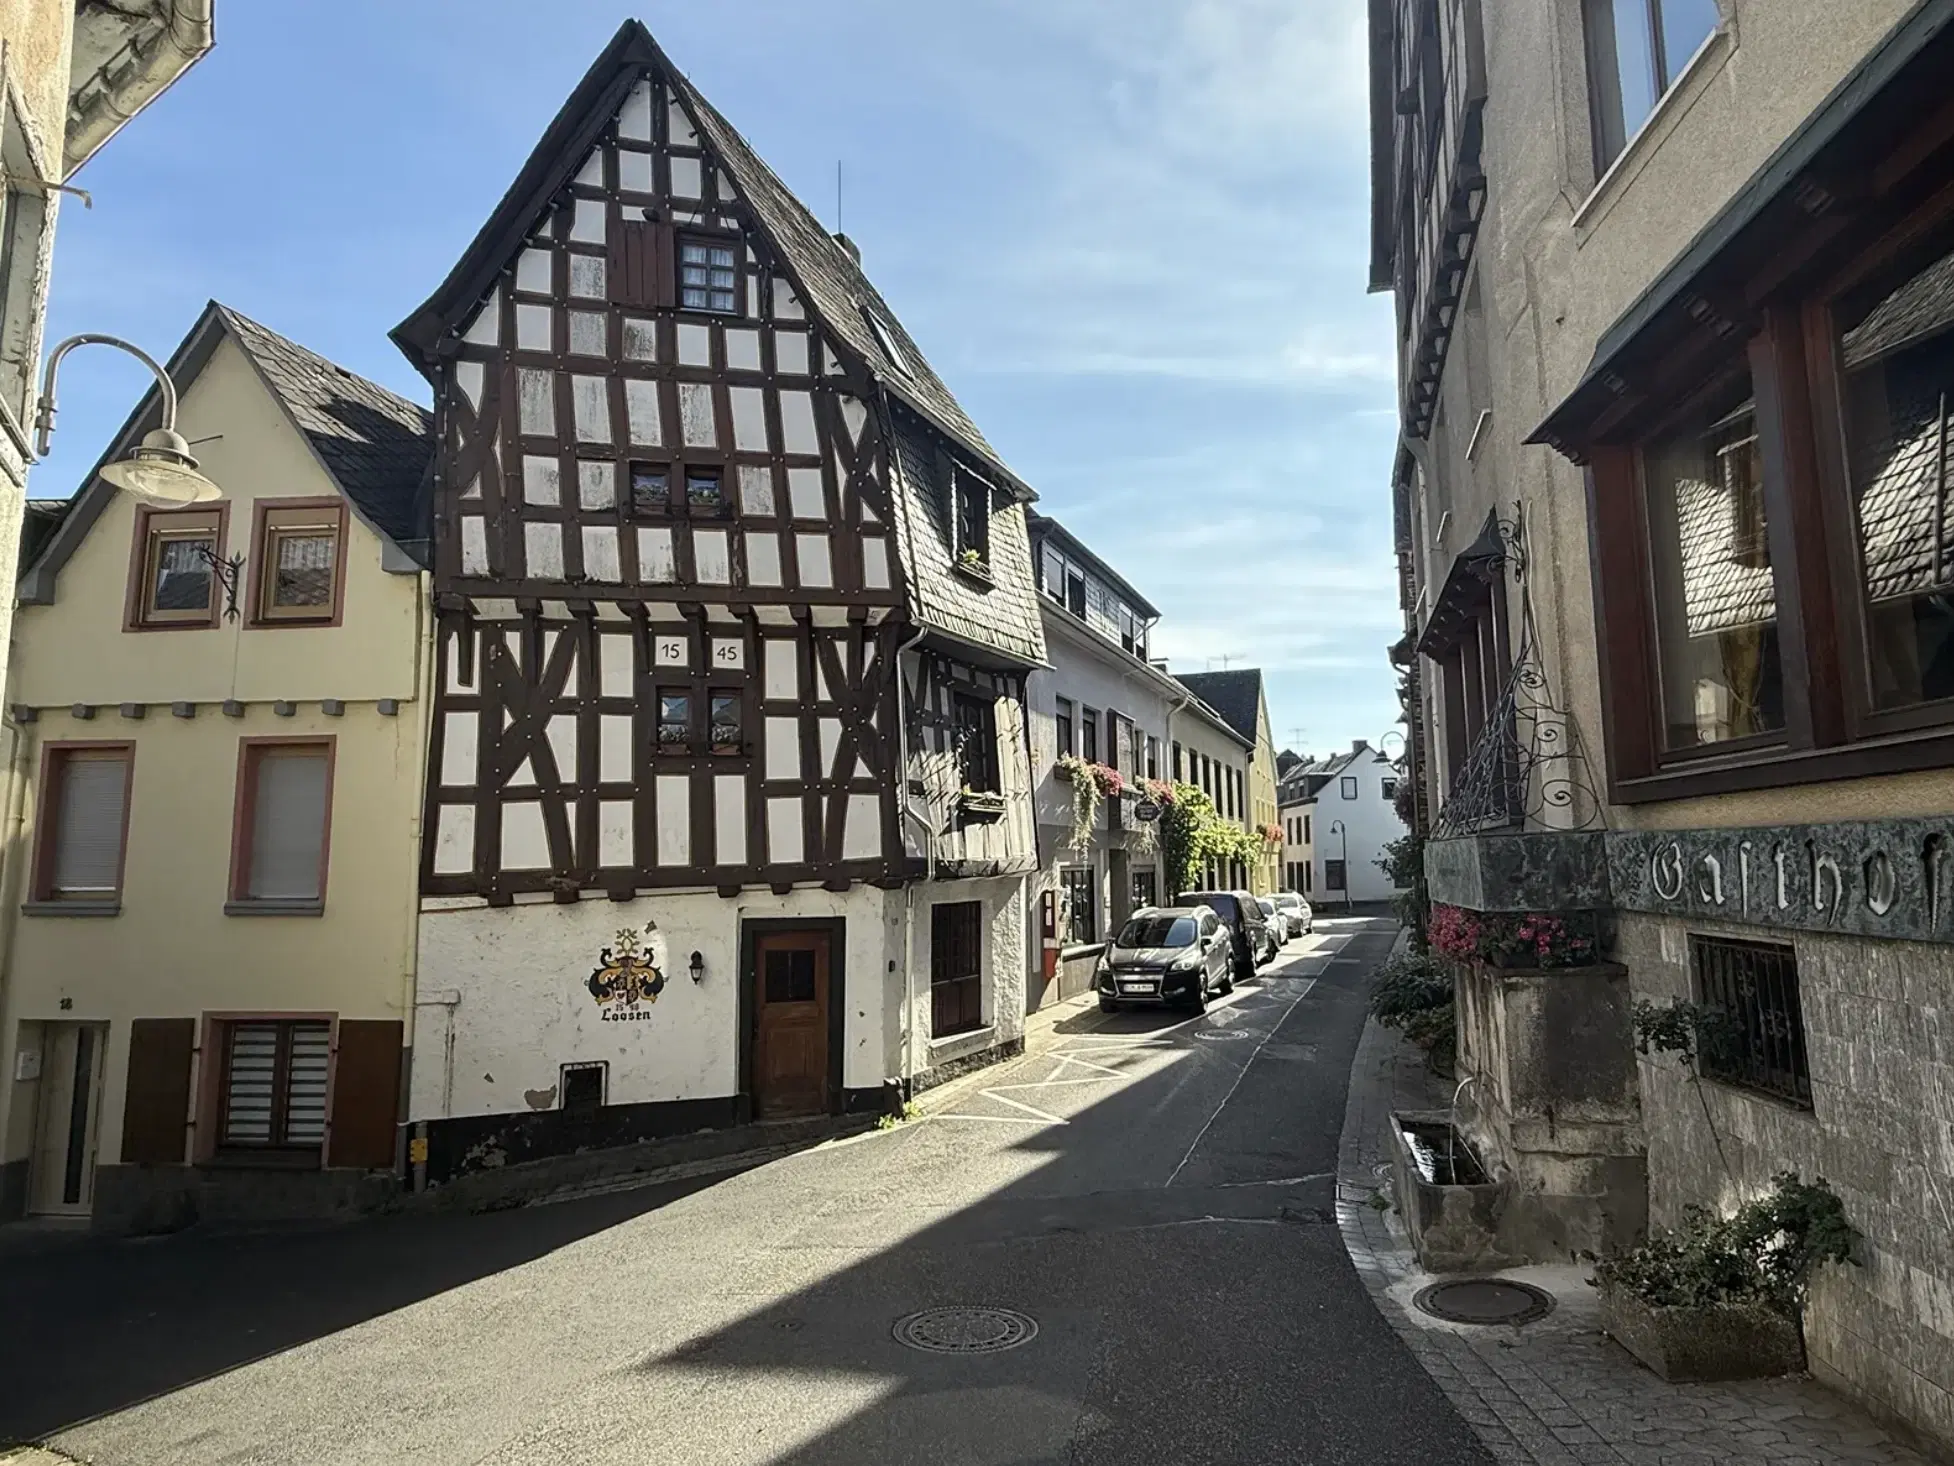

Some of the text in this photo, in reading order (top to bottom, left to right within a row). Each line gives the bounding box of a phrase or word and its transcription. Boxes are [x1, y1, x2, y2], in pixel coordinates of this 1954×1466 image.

[661, 643, 737, 661] 15 45
[601, 1007, 651, 1021] Loosen
